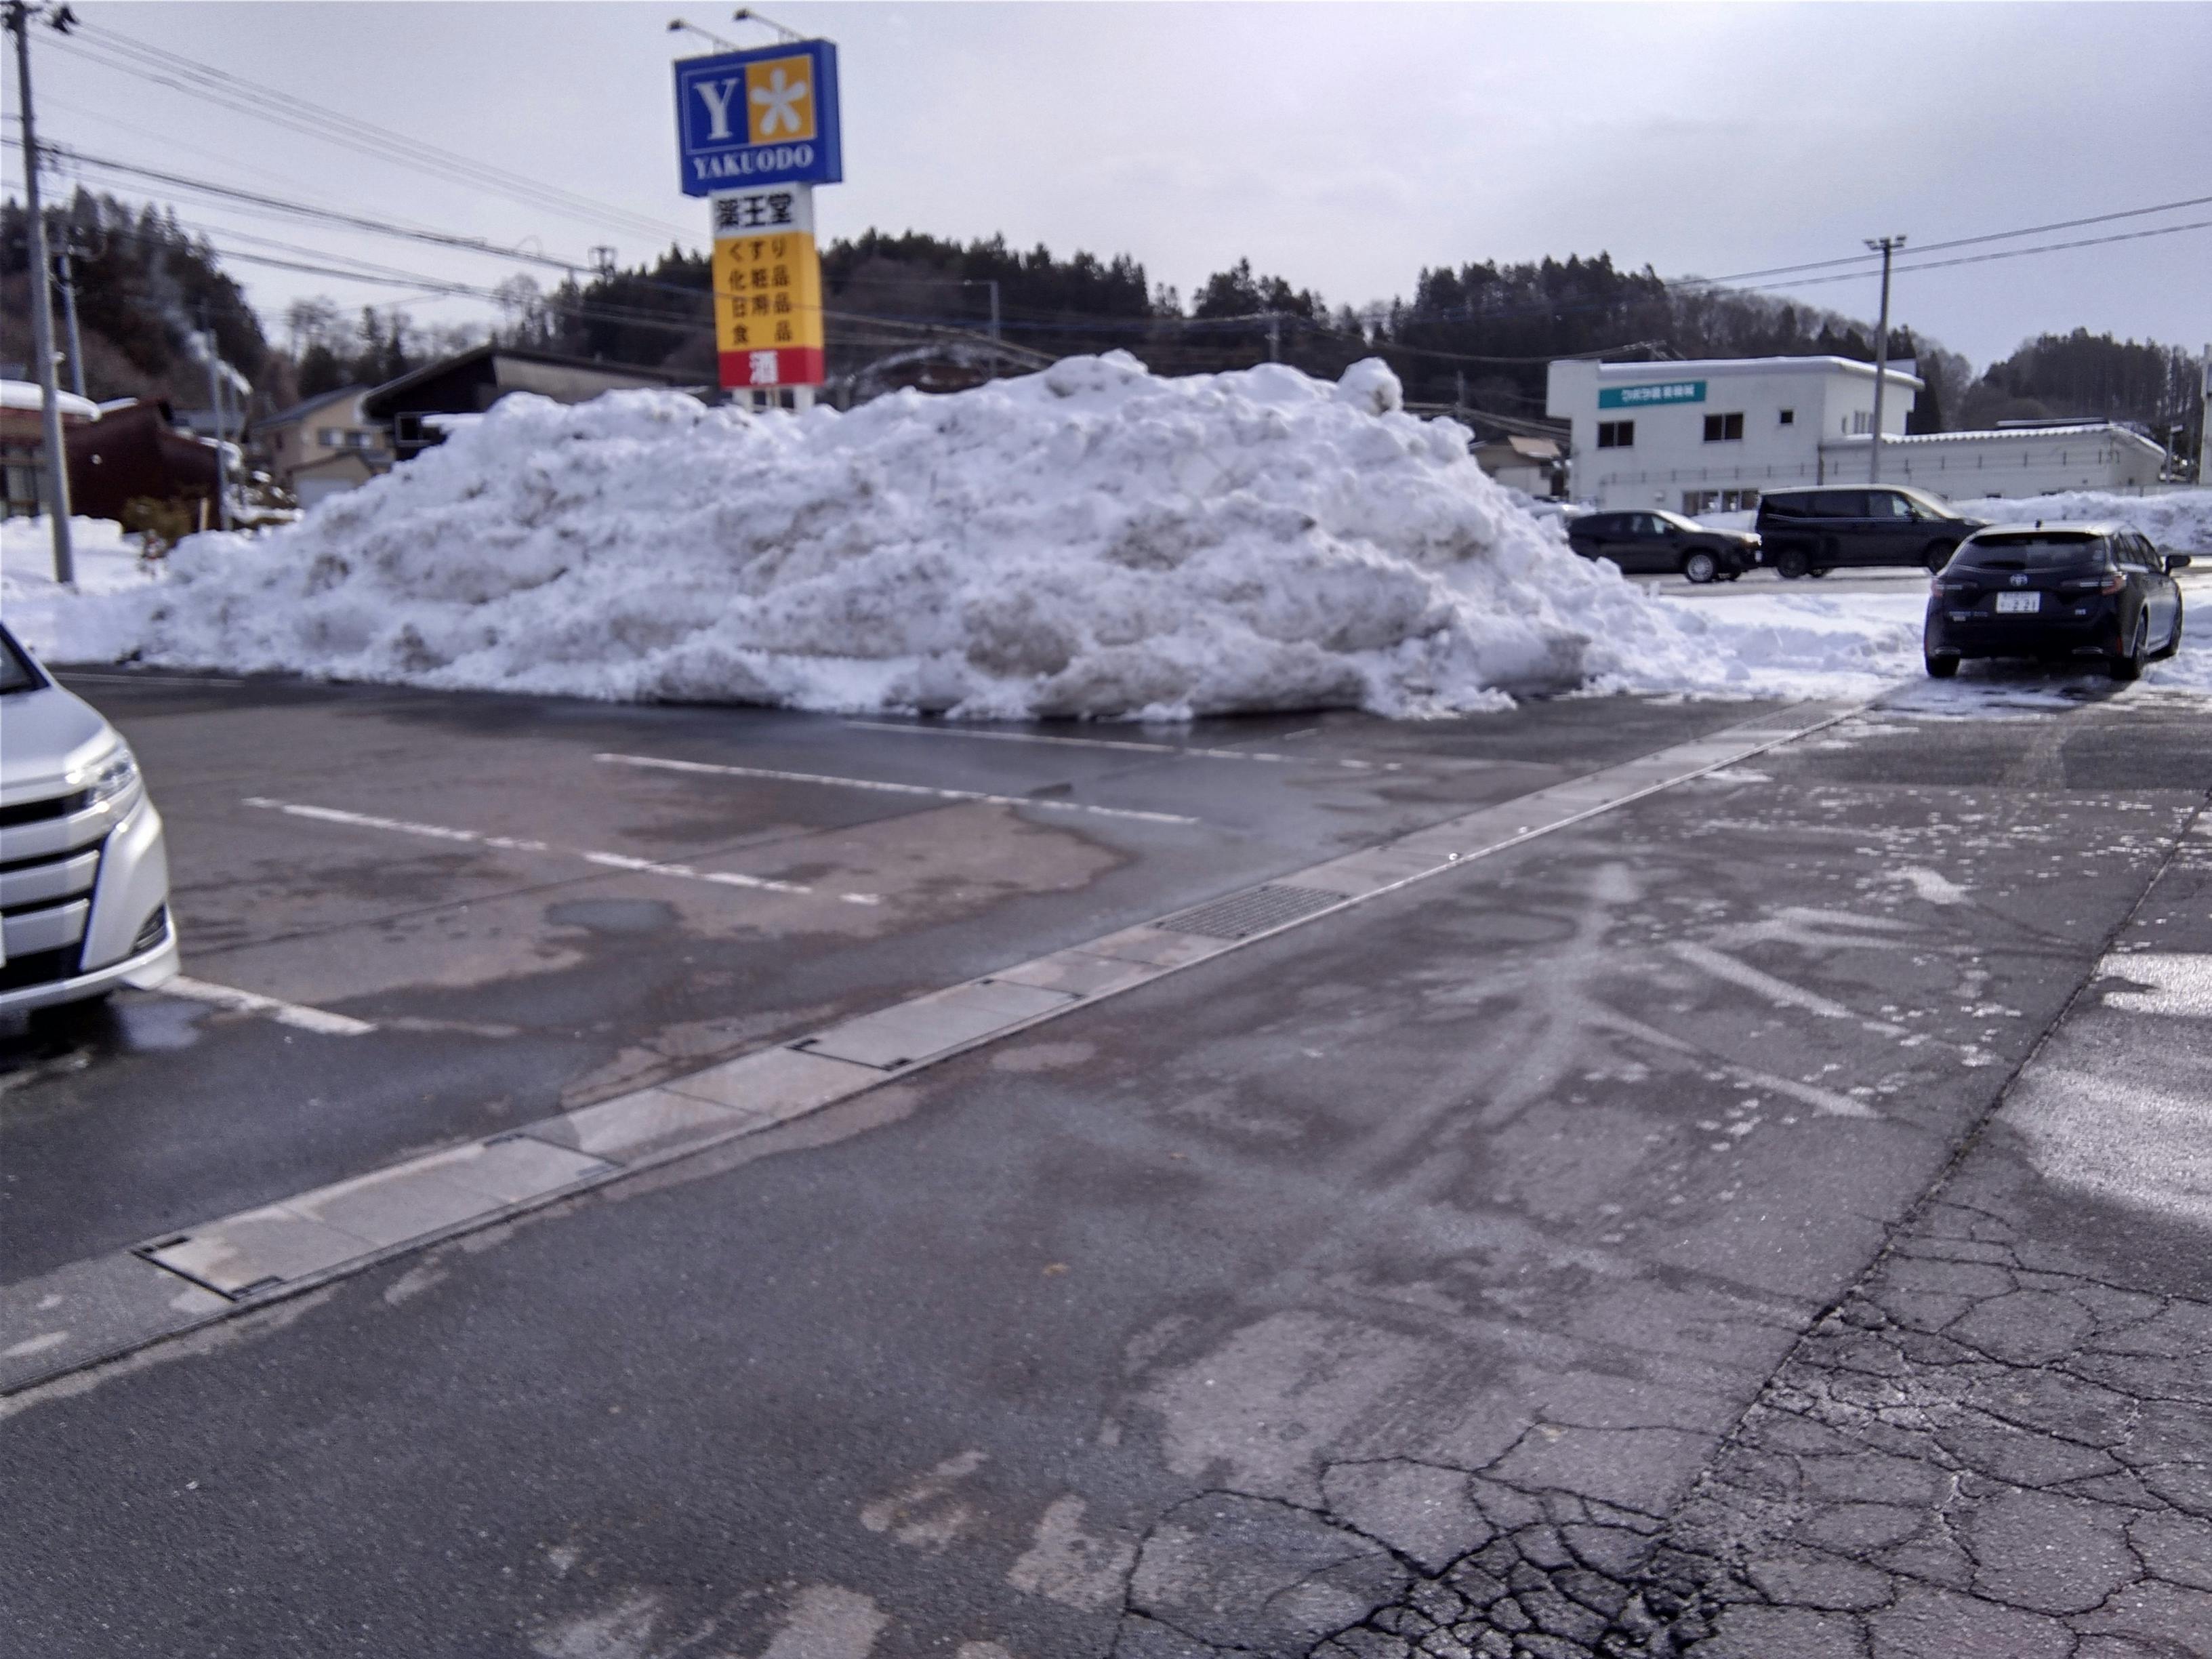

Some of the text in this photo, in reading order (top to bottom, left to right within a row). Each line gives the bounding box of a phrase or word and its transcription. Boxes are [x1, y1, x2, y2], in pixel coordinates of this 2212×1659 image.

[694, 78, 739, 140] Y
[693, 144, 813, 180] YAKUODO
[718, 194, 792, 227] 薬王堂
[729, 237, 787, 262] くすり
[730, 265, 790, 290] 化粧品
[731, 292, 792, 317] 日用品
[749, 350, 778, 385] 酒
